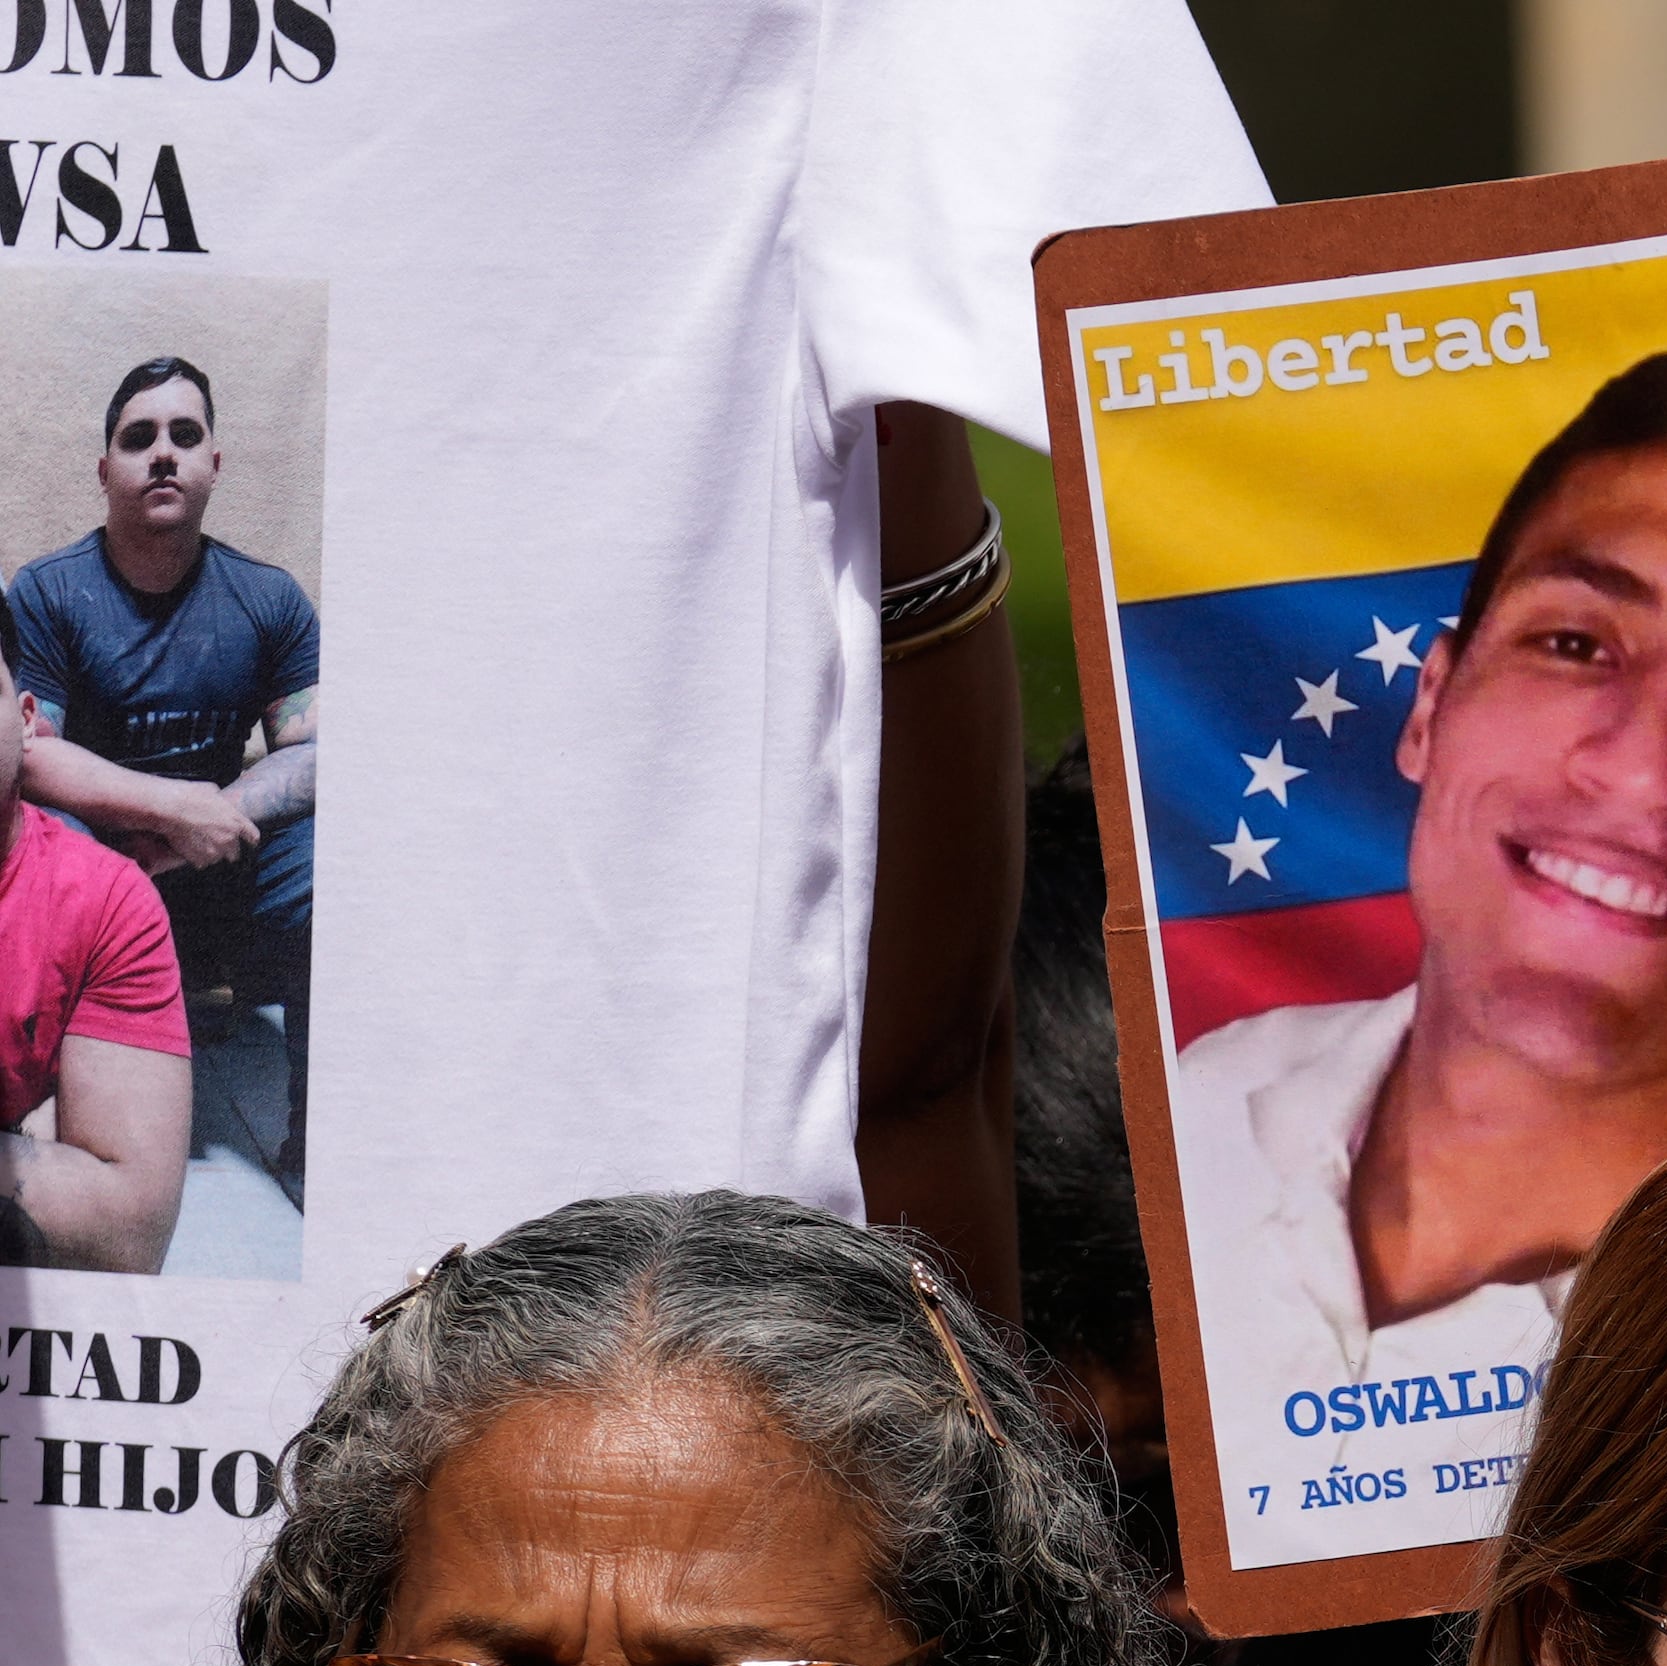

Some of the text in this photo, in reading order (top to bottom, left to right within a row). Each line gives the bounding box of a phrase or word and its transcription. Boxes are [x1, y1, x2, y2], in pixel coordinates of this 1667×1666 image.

[1093, 292, 1550, 412] Libertad
[0, 1327, 203, 1405] TAD
[1284, 1358, 1553, 1437] OSWALD
[33, 1436, 278, 1518] HIJO
[1248, 1453, 1530, 1515] 7 AÑOS DET
